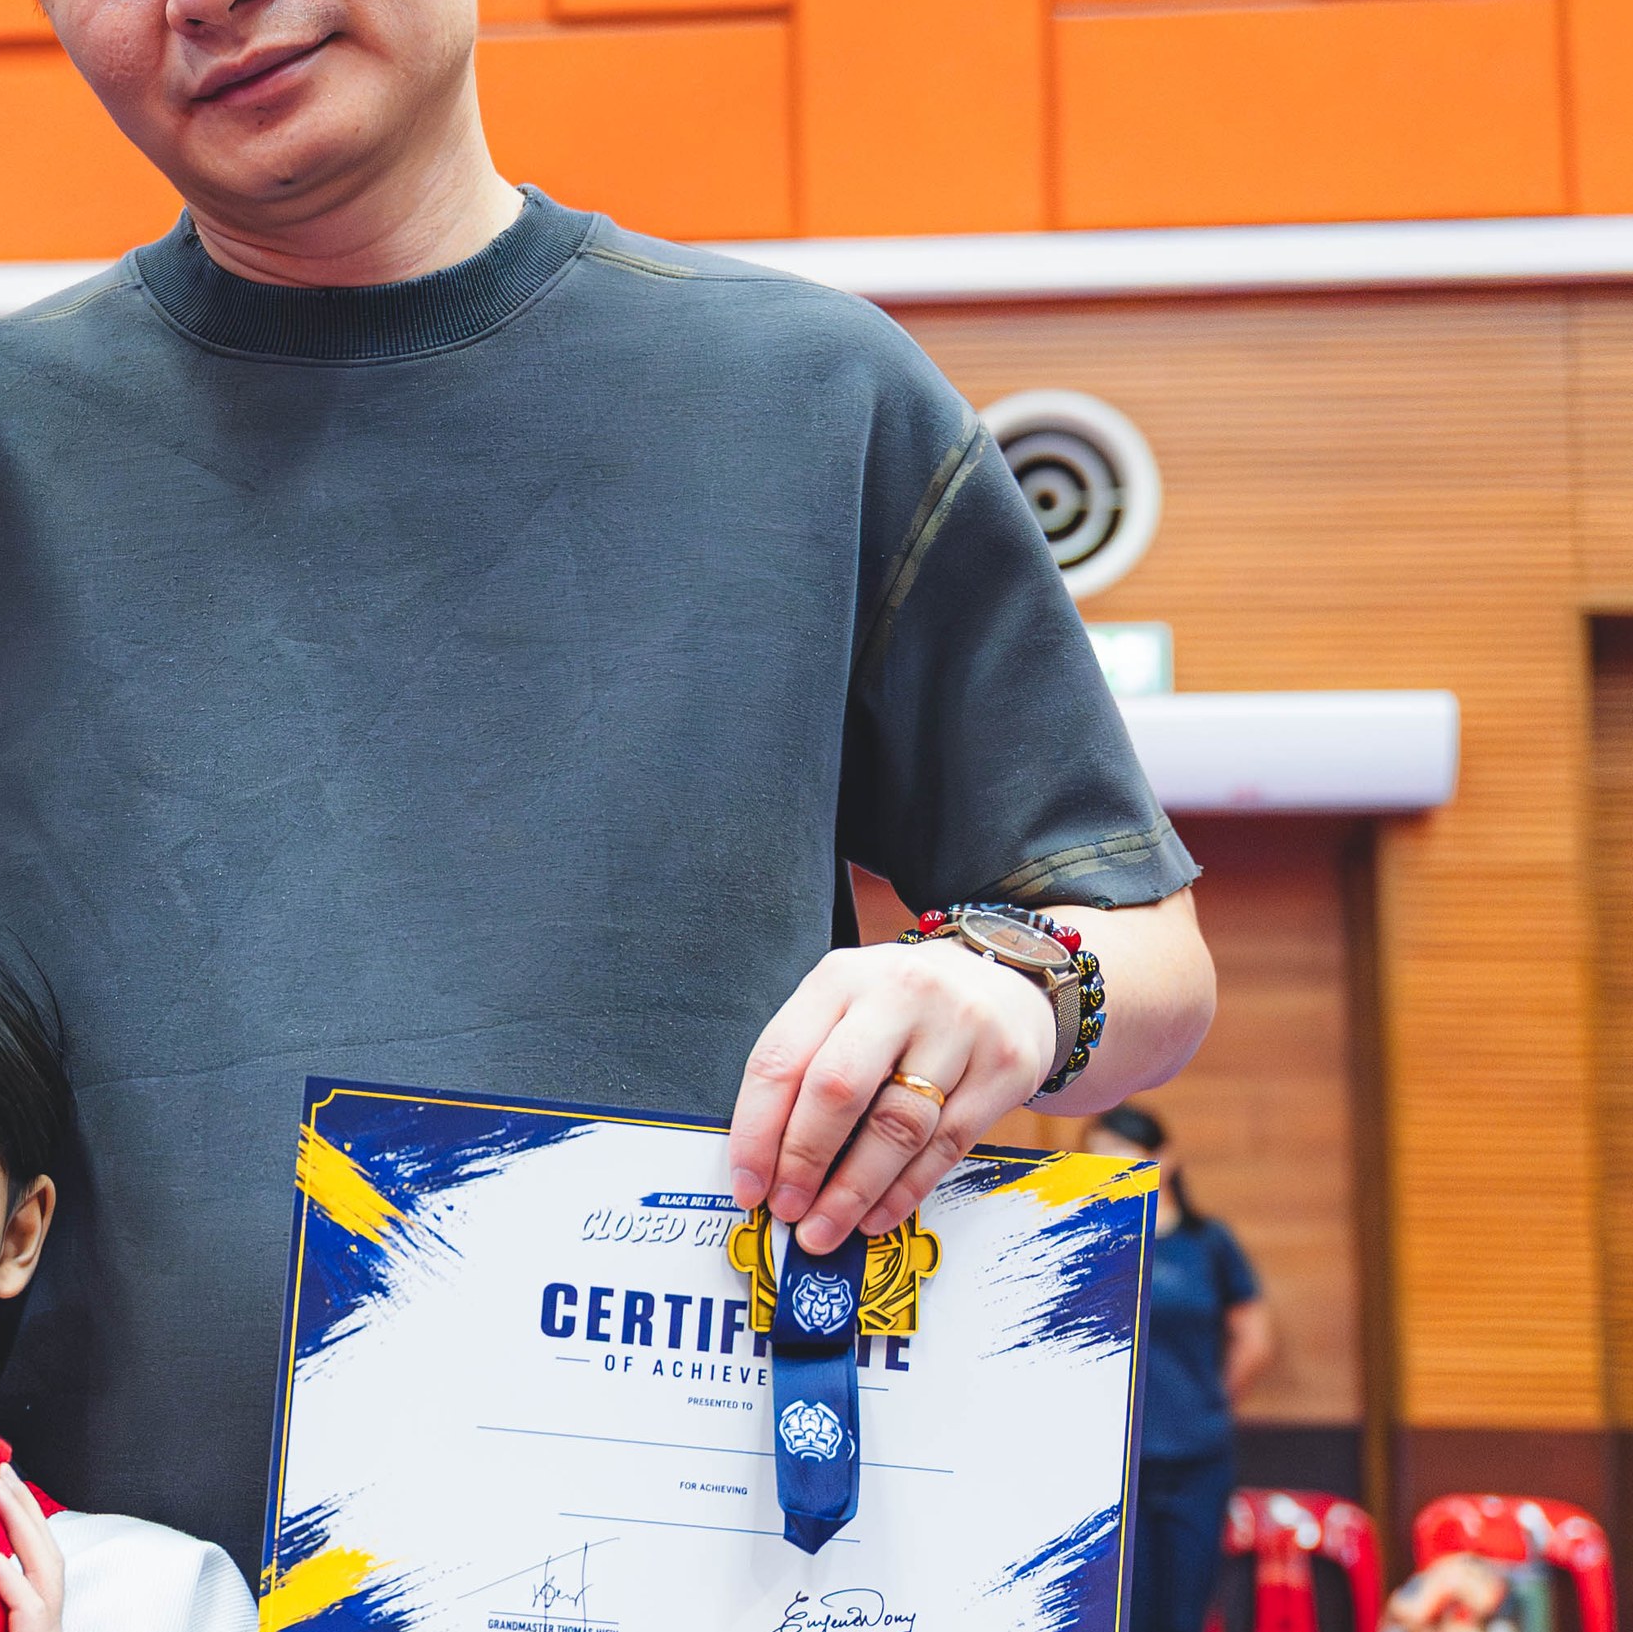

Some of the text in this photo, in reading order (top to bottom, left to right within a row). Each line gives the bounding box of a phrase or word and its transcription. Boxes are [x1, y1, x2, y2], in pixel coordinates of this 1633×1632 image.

[659, 1195, 687, 1206] BLACK
[690, 1196, 713, 1207] BELT
[582, 1207, 733, 1247] CLOSED CH
[540, 1282, 910, 1372] CERTIFE
[605, 1355, 768, 1386] OF ACHIEVE
[688, 1397, 753, 1411] PRESENTED TO
[680, 1481, 748, 1496] FOR ACHIEVING
